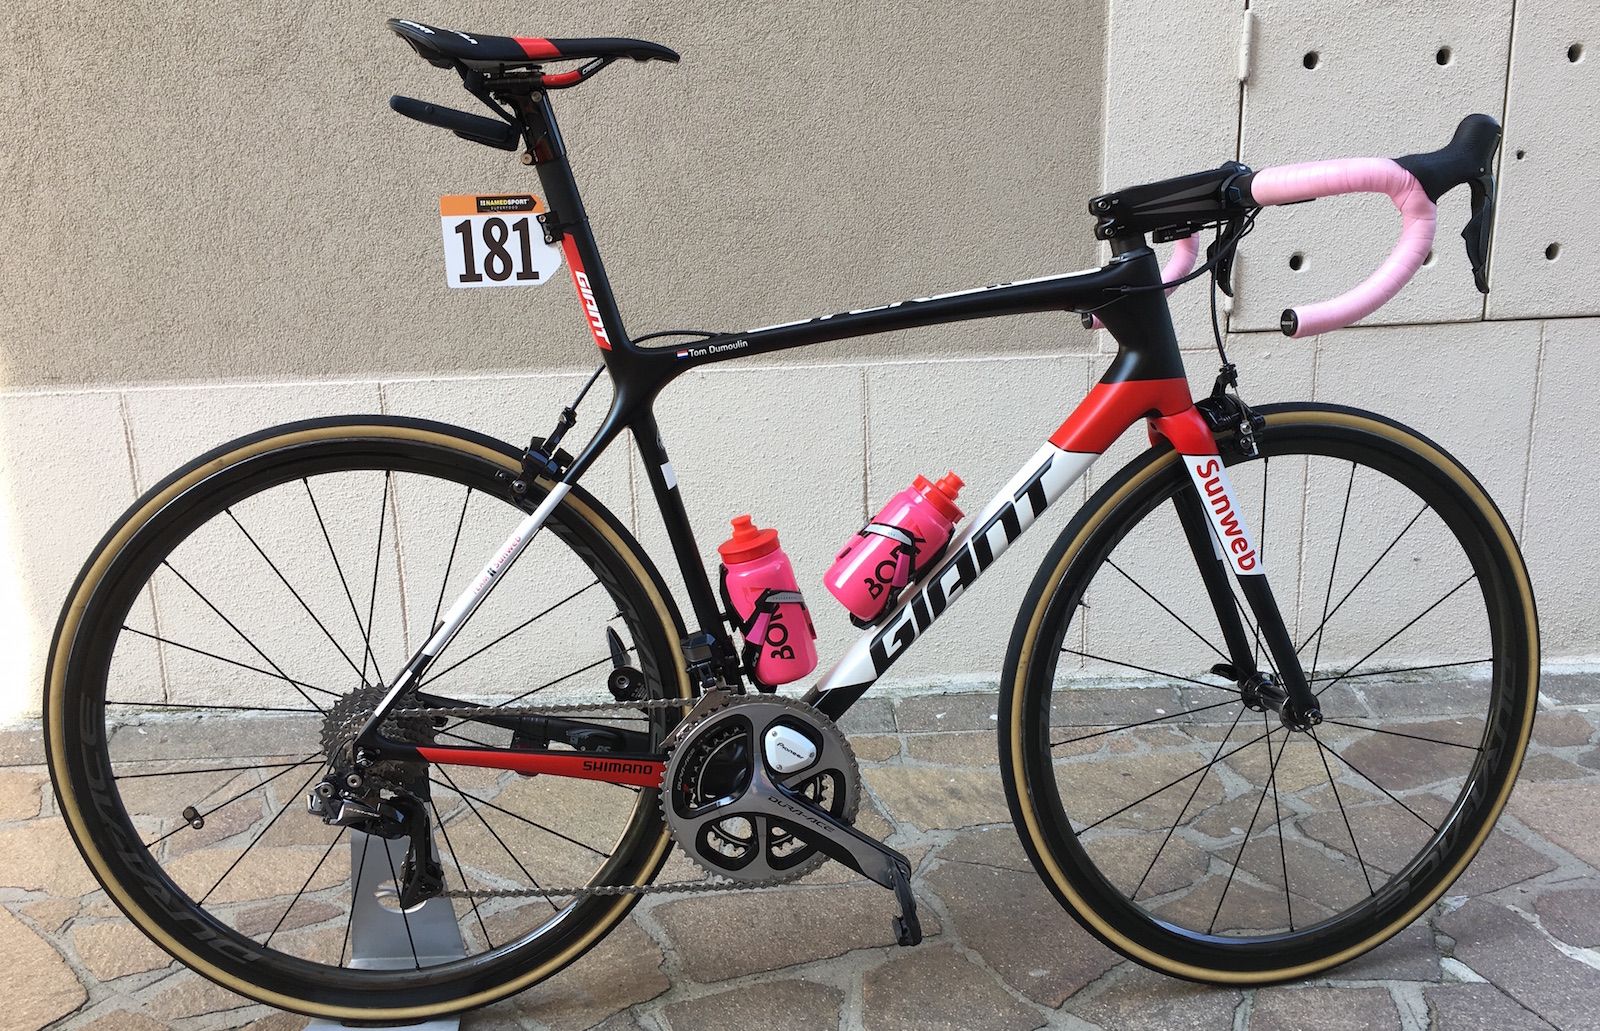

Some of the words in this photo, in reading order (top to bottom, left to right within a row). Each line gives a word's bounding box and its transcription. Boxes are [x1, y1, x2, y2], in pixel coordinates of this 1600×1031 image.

[455, 217, 539, 283] 181
[575, 270, 612, 346] GIANT
[688, 348, 707, 358] Tom
[708, 339, 749, 355] Dumoulin
[1196, 459, 1257, 572] Sunweb
[869, 452, 1056, 679] GIANT
[582, 760, 653, 775] SHIMANO
[80, 692, 263, 964] DURA-ACE
[767, 795, 836, 833] DURA-ACE
